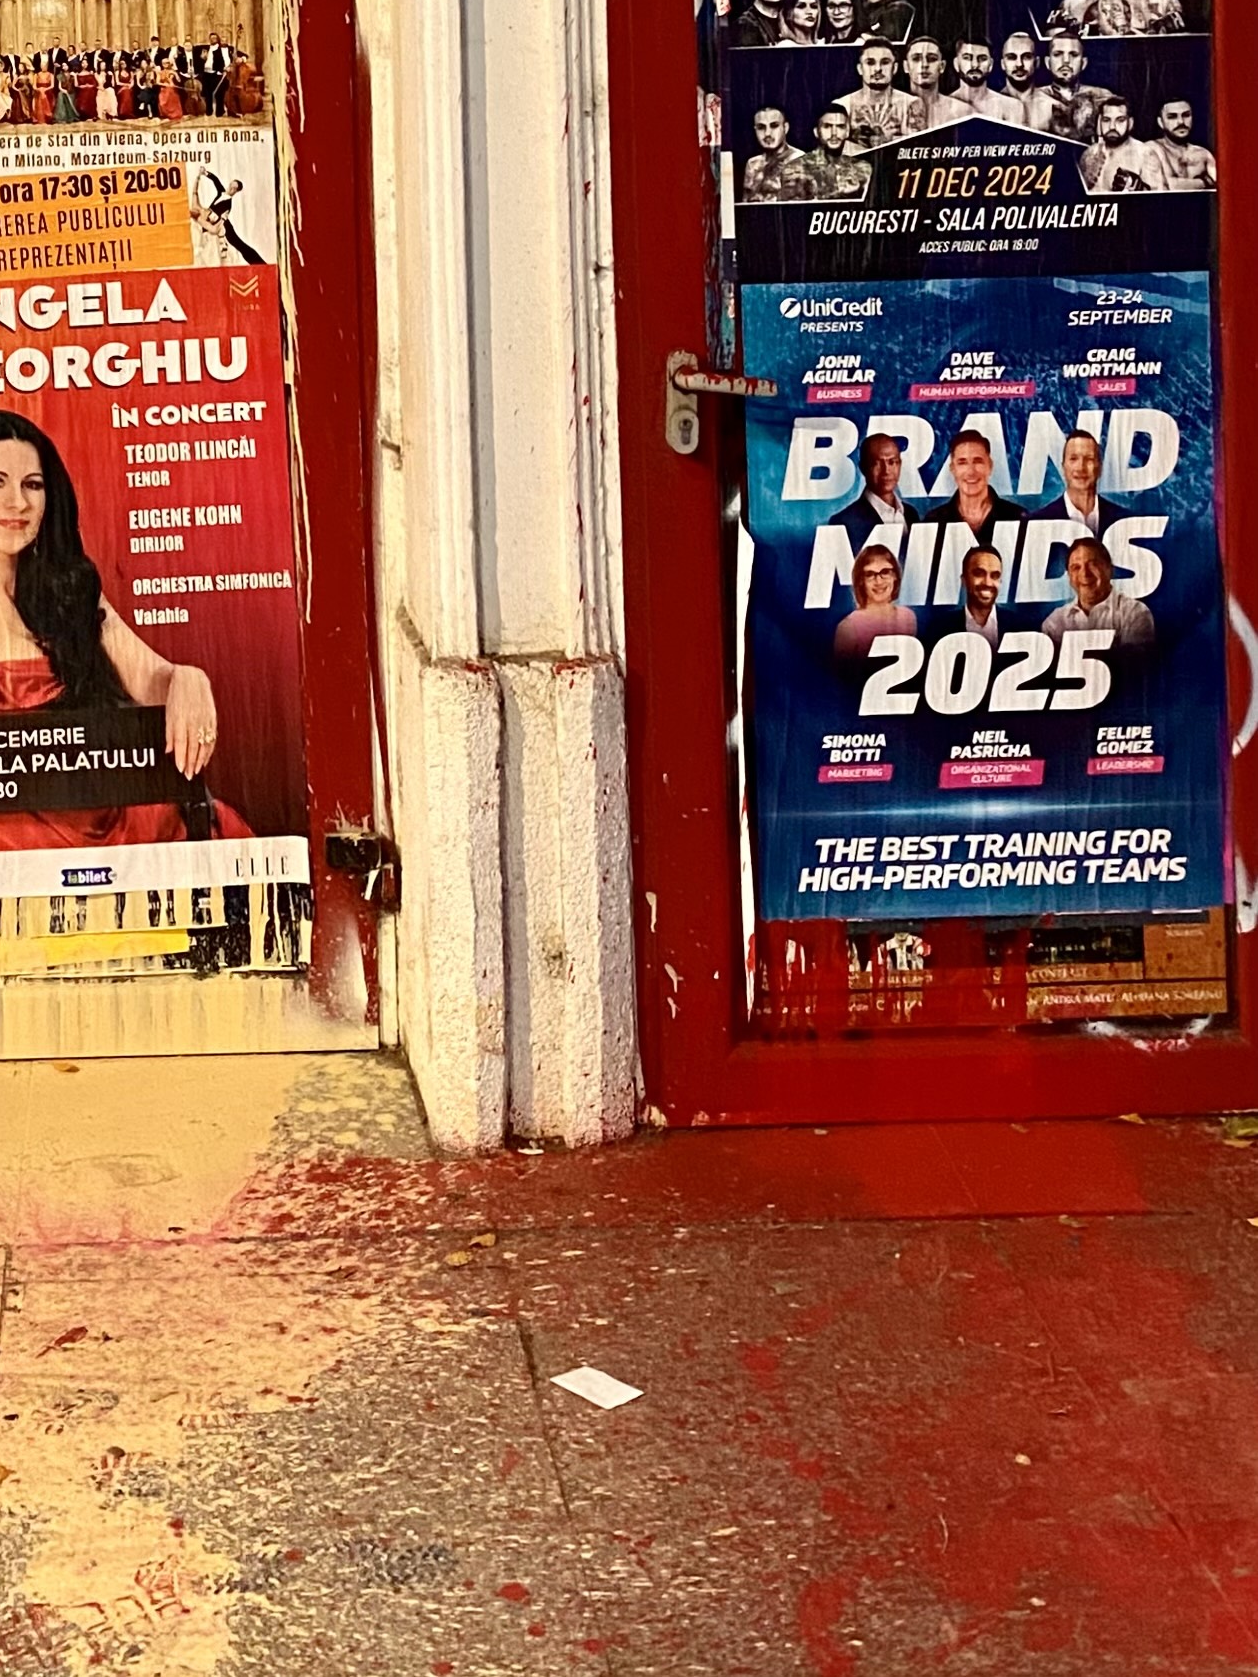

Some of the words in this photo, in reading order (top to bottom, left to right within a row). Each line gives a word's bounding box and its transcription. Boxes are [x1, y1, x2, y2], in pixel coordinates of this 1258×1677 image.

[0, 182, 34, 204] ora
[38, 173, 93, 201] 17:30
[123, 166, 182, 194] 20:00
[898, 167, 920, 199] 11
[926, 167, 979, 198] DEC
[983, 164, 1054, 197] 2024
[57, 202, 167, 233] PUBLICULUI
[808, 208, 918, 235] BUCURESTI
[936, 205, 985, 231] SALA
[991, 202, 1119, 230] POLIVALENTA
[802, 297, 883, 317] UniCredit
[1096, 290, 1142, 306] 23-24
[800, 321, 864, 333] PRESENTS
[1068, 309, 1173, 327] SEPTEMBER
[816, 355, 861, 370] JOHN
[950, 351, 995, 366] DAVE
[1086, 348, 1136, 362] CRAIG
[802, 369, 876, 385] AGUILAR
[939, 366, 1006, 382] ASPREY
[1062, 361, 1162, 378] WORTMANN
[816, 389, 863, 400] BUSINESS
[918, 387, 955, 398] HUMAN
[956, 385, 1026, 397] PERFORMANCE
[1096, 382, 1127, 392] SALES
[112, 403, 139, 429] ÎN
[144, 400, 267, 426] CONCERT
[124, 441, 191, 465] TEODOR
[195, 435, 257, 461] ILINCĂI
[781, 408, 1181, 501] BRAND
[126, 470, 171, 489] TENOR
[128, 507, 191, 530] EUGENE
[195, 504, 243, 527] KOHN
[130, 534, 184, 555] DIRIJOR
[803, 516, 1169, 609] MINDS
[133, 575, 213, 597] ORCHESTRA
[216, 569, 292, 592] SIMFONICĂ
[134, 606, 189, 626] Valahia
[858, 629, 1116, 716] 2025
[822, 733, 887, 749] SIMONA
[972, 730, 1009, 744] NEIL
[1097, 726, 1153, 741] FELIPE
[829, 748, 881, 764] BOTTI
[950, 744, 1032, 759] PASRICHA
[1096, 740, 1155, 755] GOMEZ
[32, 747, 156, 772] PALATULUI
[950, 764, 1031, 775] ORGANIZATIONAL
[970, 773, 1013, 784] CULTURE
[815, 836, 877, 864] THE
[880, 835, 959, 863] BEST
[963, 829, 1106, 860] TRAINING
[1111, 828, 1172, 855] FOR
[236, 856, 289, 877] ELLE
[798, 859, 1079, 893] HIGH-PERFORMING
[1083, 857, 1188, 884] TEAMS
